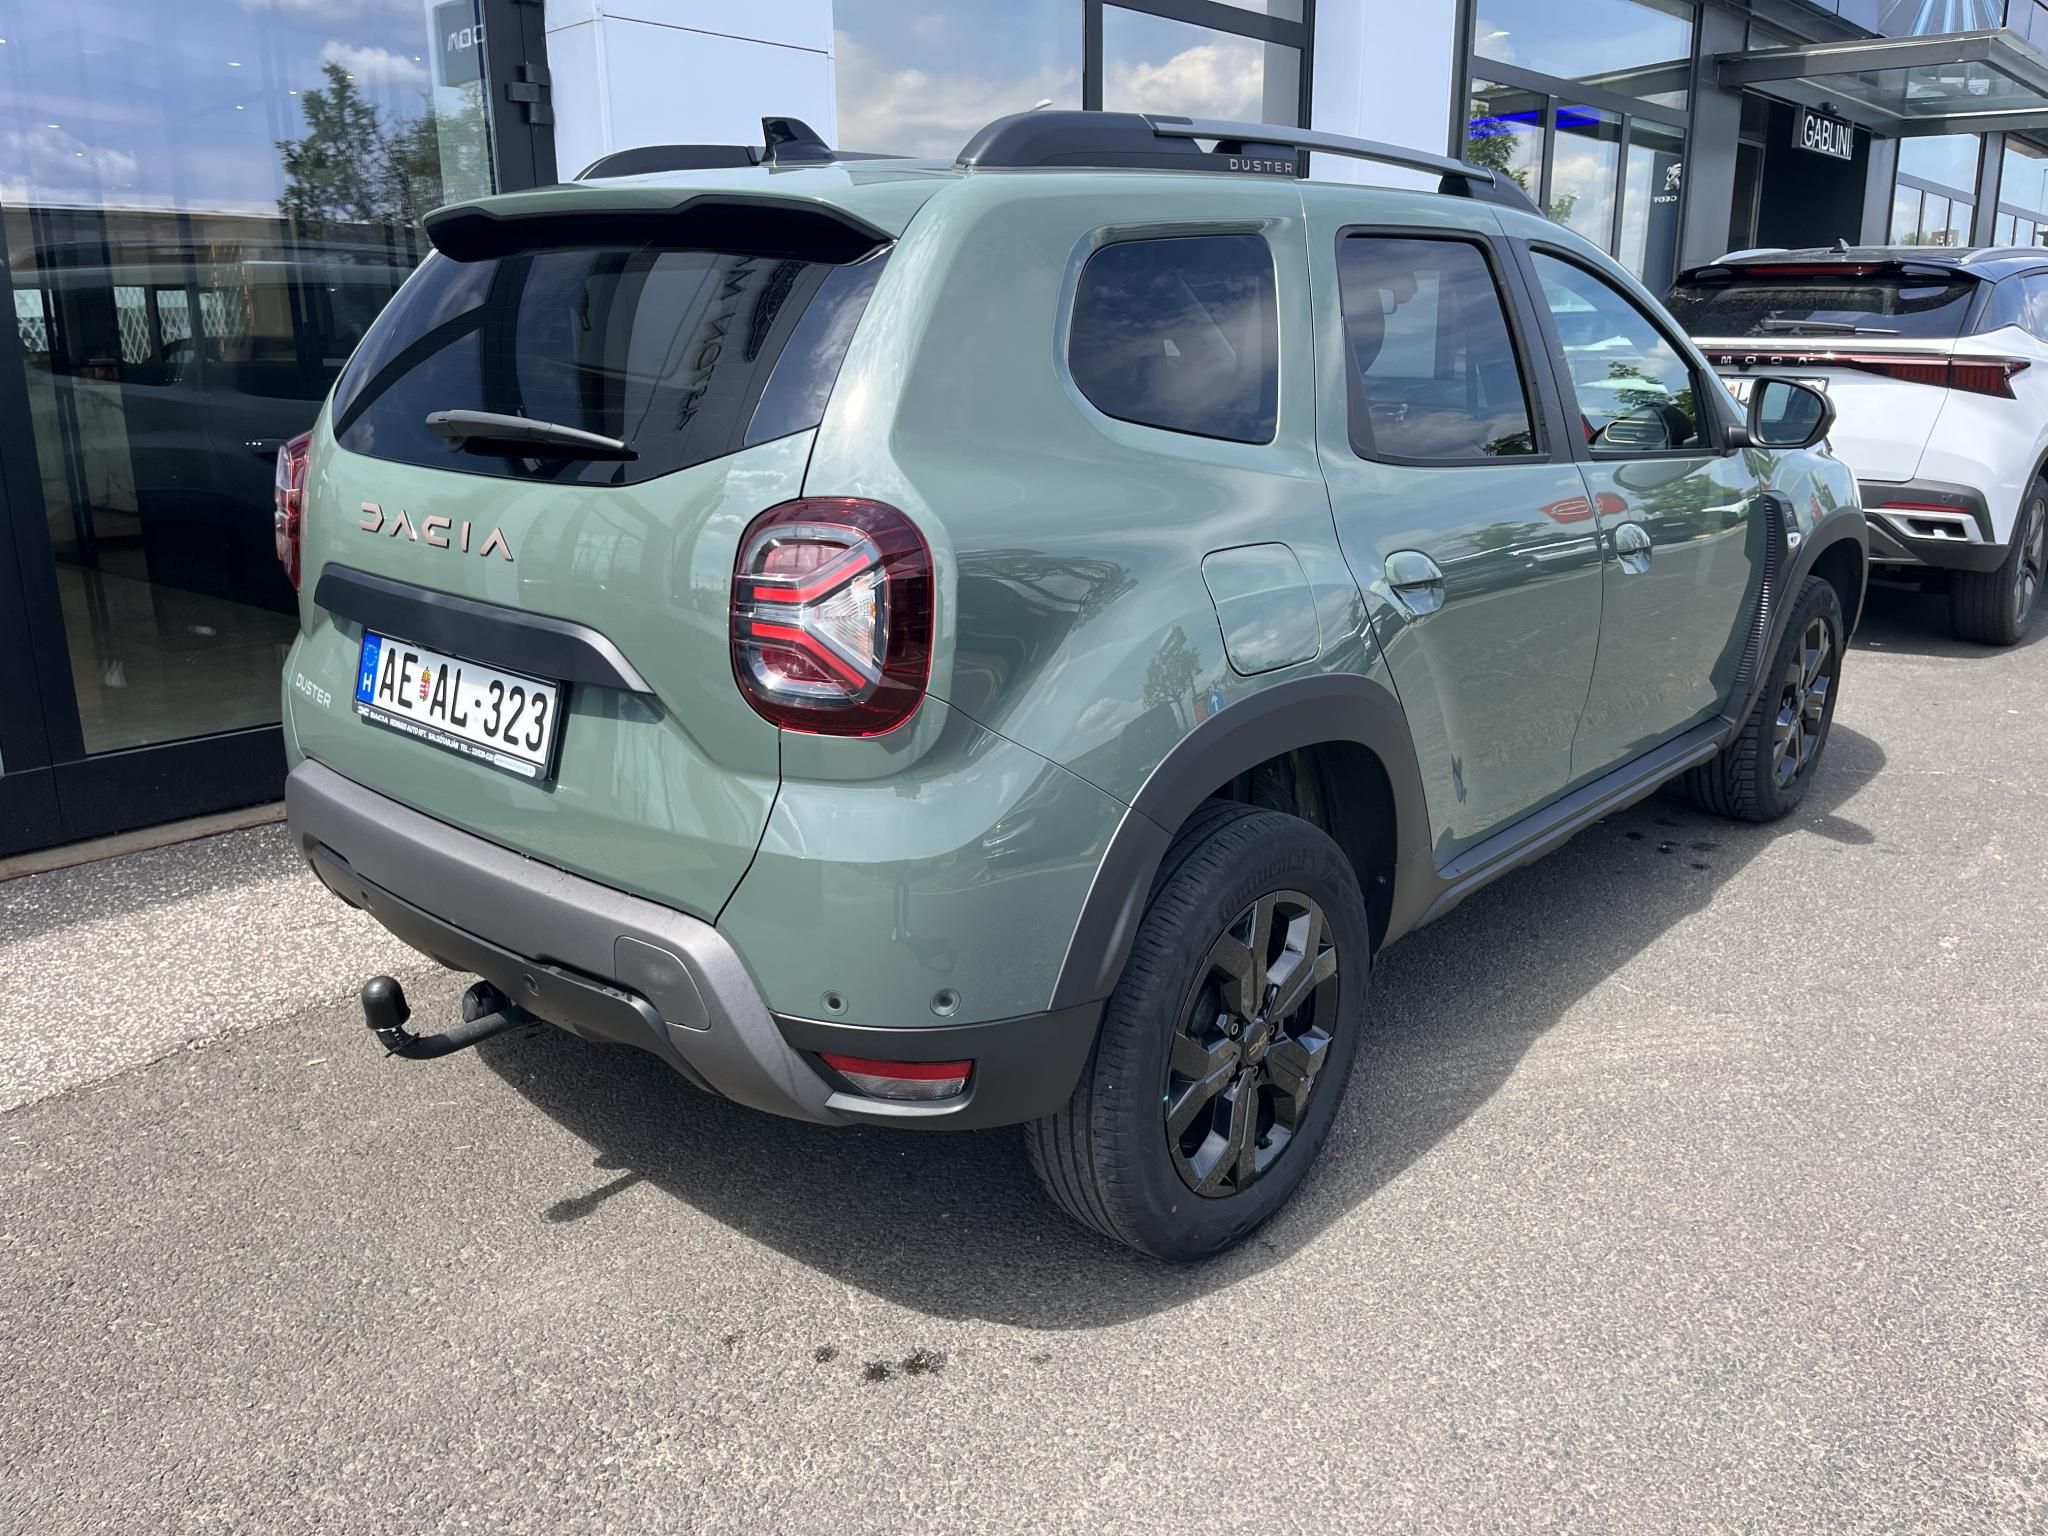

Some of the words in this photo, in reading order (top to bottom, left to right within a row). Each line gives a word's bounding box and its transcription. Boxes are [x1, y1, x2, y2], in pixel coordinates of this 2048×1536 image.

[1804, 115, 1851, 157] GABLINI
[1229, 158, 1293, 173] DUSTER
[1705, 355, 1808, 366] MODA
[359, 501, 514, 562] DACIA
[295, 672, 332, 709] DUSTER
[362, 672, 372, 693] H
[369, 711, 389, 724] DACIA
